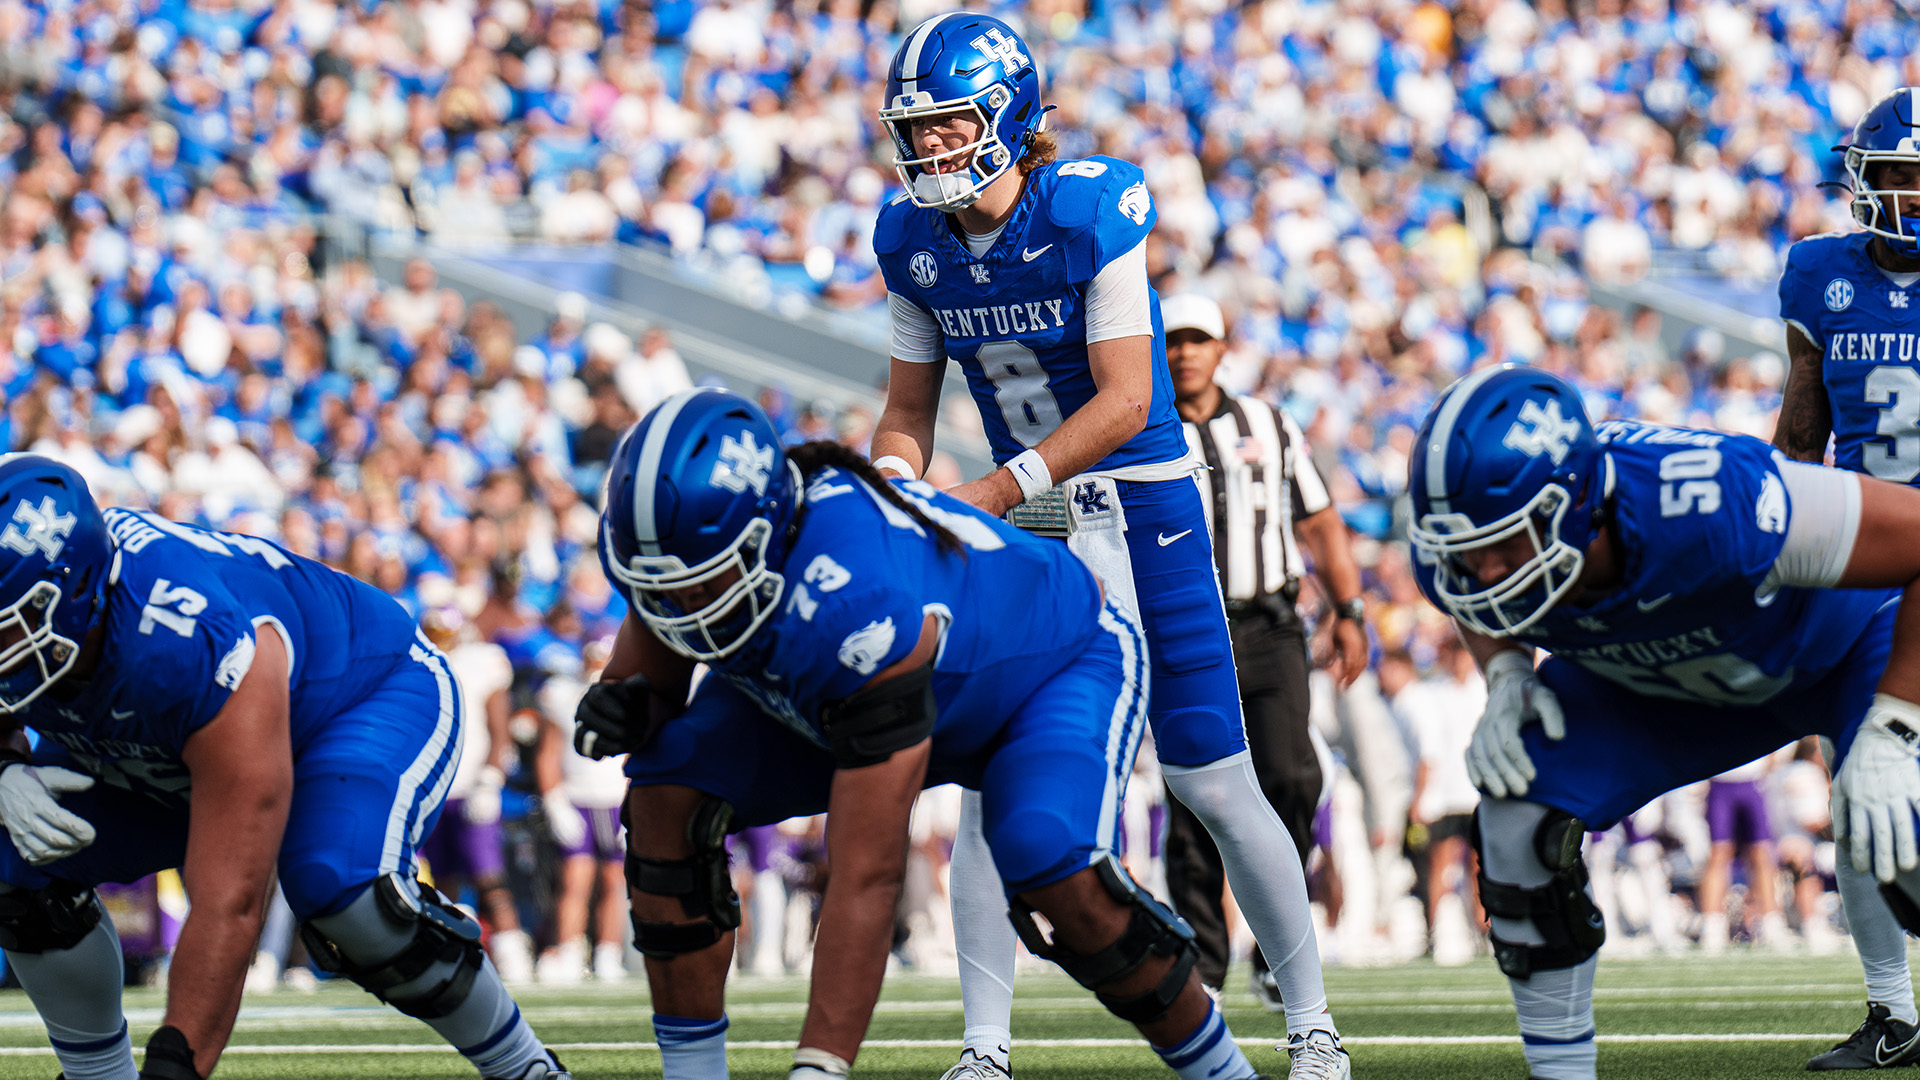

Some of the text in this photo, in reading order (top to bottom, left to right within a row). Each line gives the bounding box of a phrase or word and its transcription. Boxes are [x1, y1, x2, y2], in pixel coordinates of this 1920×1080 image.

[969, 27, 1030, 76] UK
[1056, 161, 1108, 178] 8
[911, 254, 937, 286] SEC
[968, 263, 991, 284] UK
[1827, 281, 1851, 309] SEC
[1888, 291, 1909, 308] UK
[1830, 333, 1920, 362] KENTU
[975, 339, 1063, 449] 8
[1502, 398, 1581, 467] UK
[709, 430, 775, 498] UK
[1659, 448, 1722, 517] 50
[1073, 482, 1110, 515] UK
[0, 495, 78, 563] UK
[138, 578, 208, 638] 75
[786, 554, 852, 622] 73
